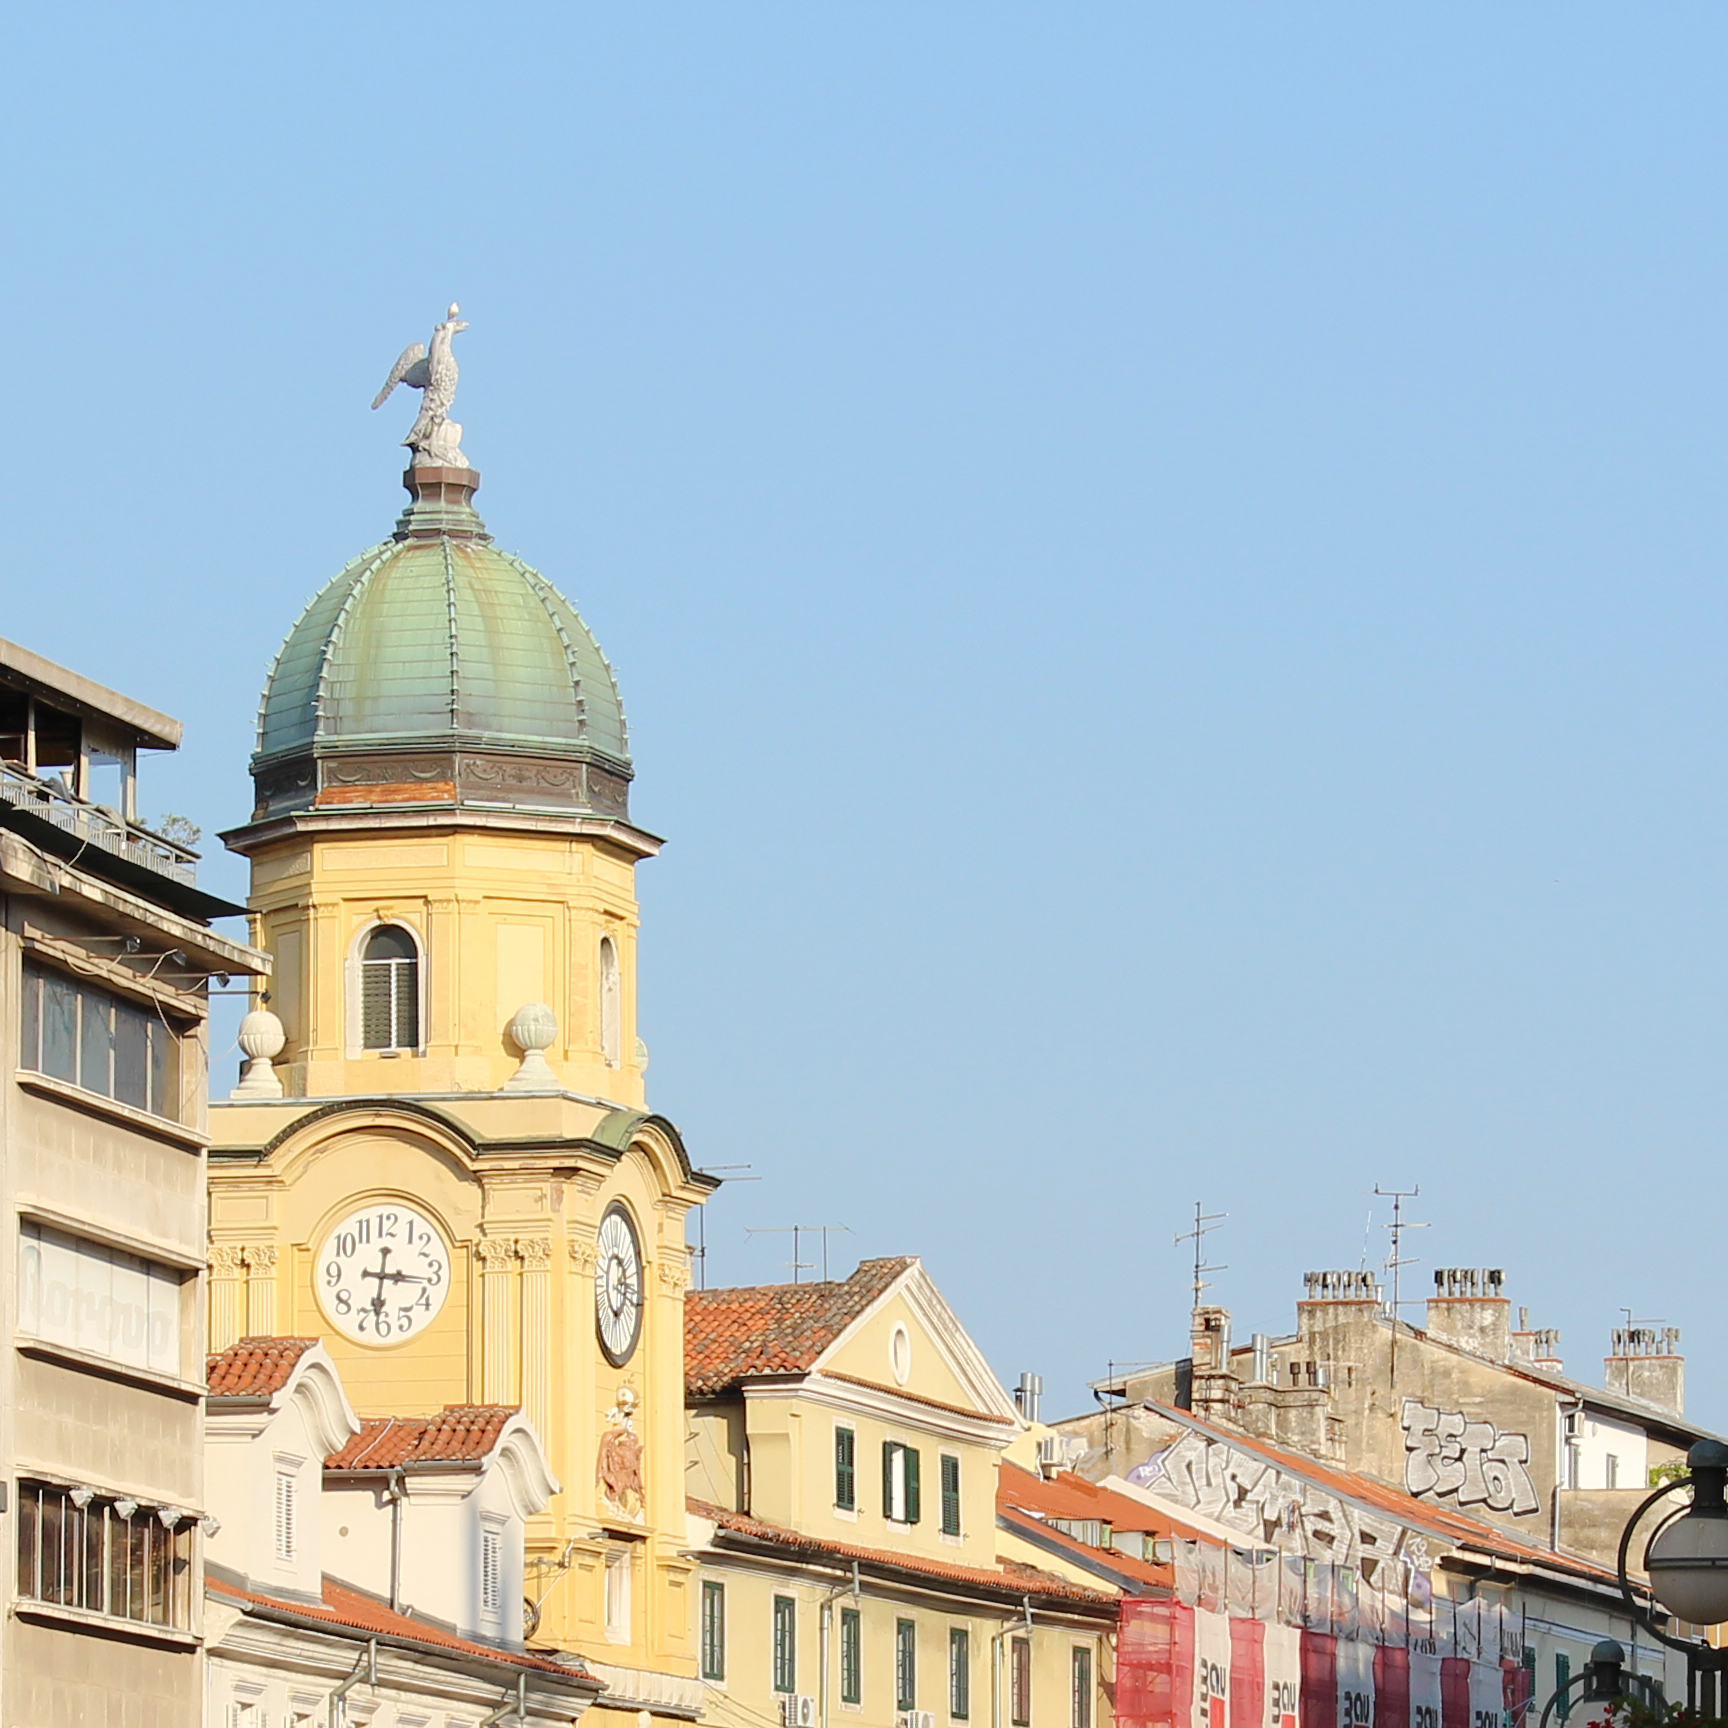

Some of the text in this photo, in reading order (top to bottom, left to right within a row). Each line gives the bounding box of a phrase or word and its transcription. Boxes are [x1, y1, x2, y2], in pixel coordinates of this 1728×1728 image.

[355, 1218, 371, 1244] 11
[376, 1213, 398, 1239] 12
[406, 1218, 414, 1245] 1
[334, 1232, 356, 1258] 10
[417, 1232, 431, 1258] 2
[326, 1261, 342, 1287] 9
[427, 1259, 442, 1286] 3
[335, 1289, 352, 1315] 8
[415, 1286, 432, 1312] 4
[357, 1307, 372, 1332] 7
[375, 1310, 391, 1338] 6
[397, 1305, 414, 1332] 5
